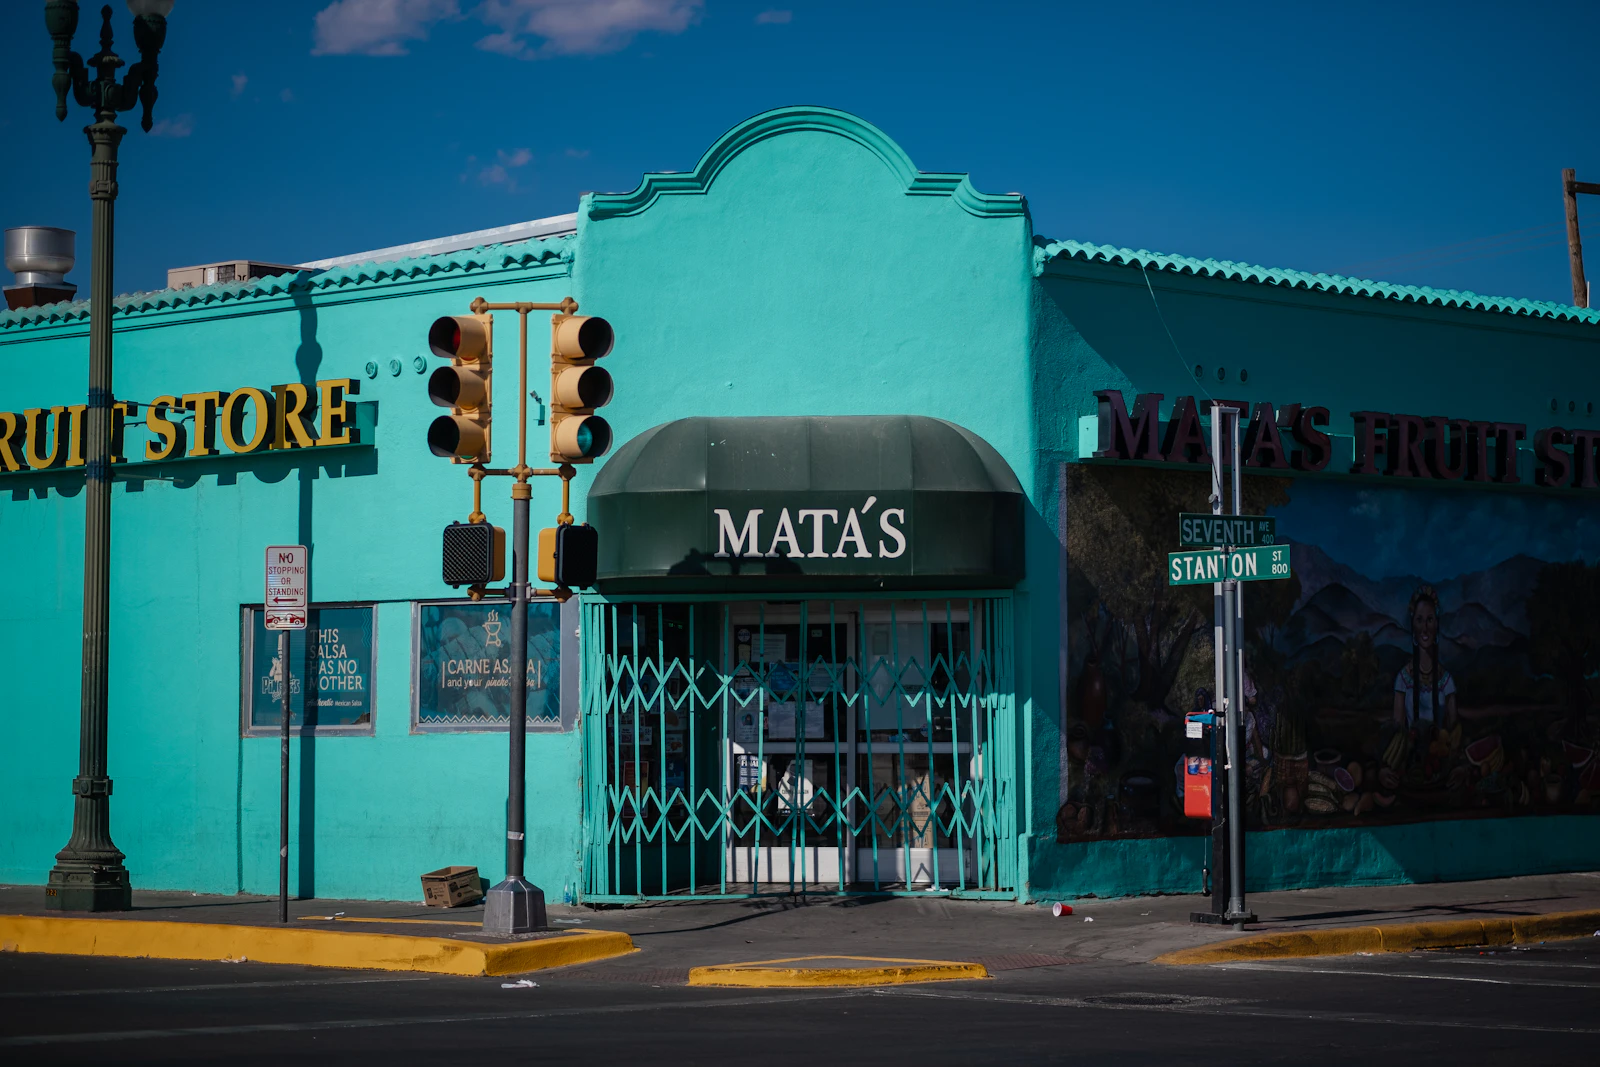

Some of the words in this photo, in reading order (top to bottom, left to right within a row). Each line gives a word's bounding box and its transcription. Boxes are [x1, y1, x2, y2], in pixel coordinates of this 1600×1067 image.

[145, 378, 358, 461] STORE
[1350, 410, 1526, 483] FRUIT
[1534, 427, 1600, 488] ST
[1182, 519, 1254, 544] SEVENTH
[1258, 521, 1269, 532] AVE
[1261, 534, 1274, 545] 400
[278, 552, 294, 564] NO
[1171, 552, 1257, 581] STANTON
[1272, 550, 1282, 562] ST
[268, 566, 304, 575] STOPPING
[1271, 563, 1288, 574] 800
[280, 577, 291, 585] OR
[268, 588, 304, 596] STANDING
[310, 628, 339, 643] THIS
[309, 644, 347, 659] SALSA
[309, 659, 334, 675] HAS
[337, 659, 357, 674] NO
[447, 659, 490, 675] CARNE
[493, 658, 536, 674] ASA
[447, 677, 462, 687] and
[464, 678, 482, 690] your
